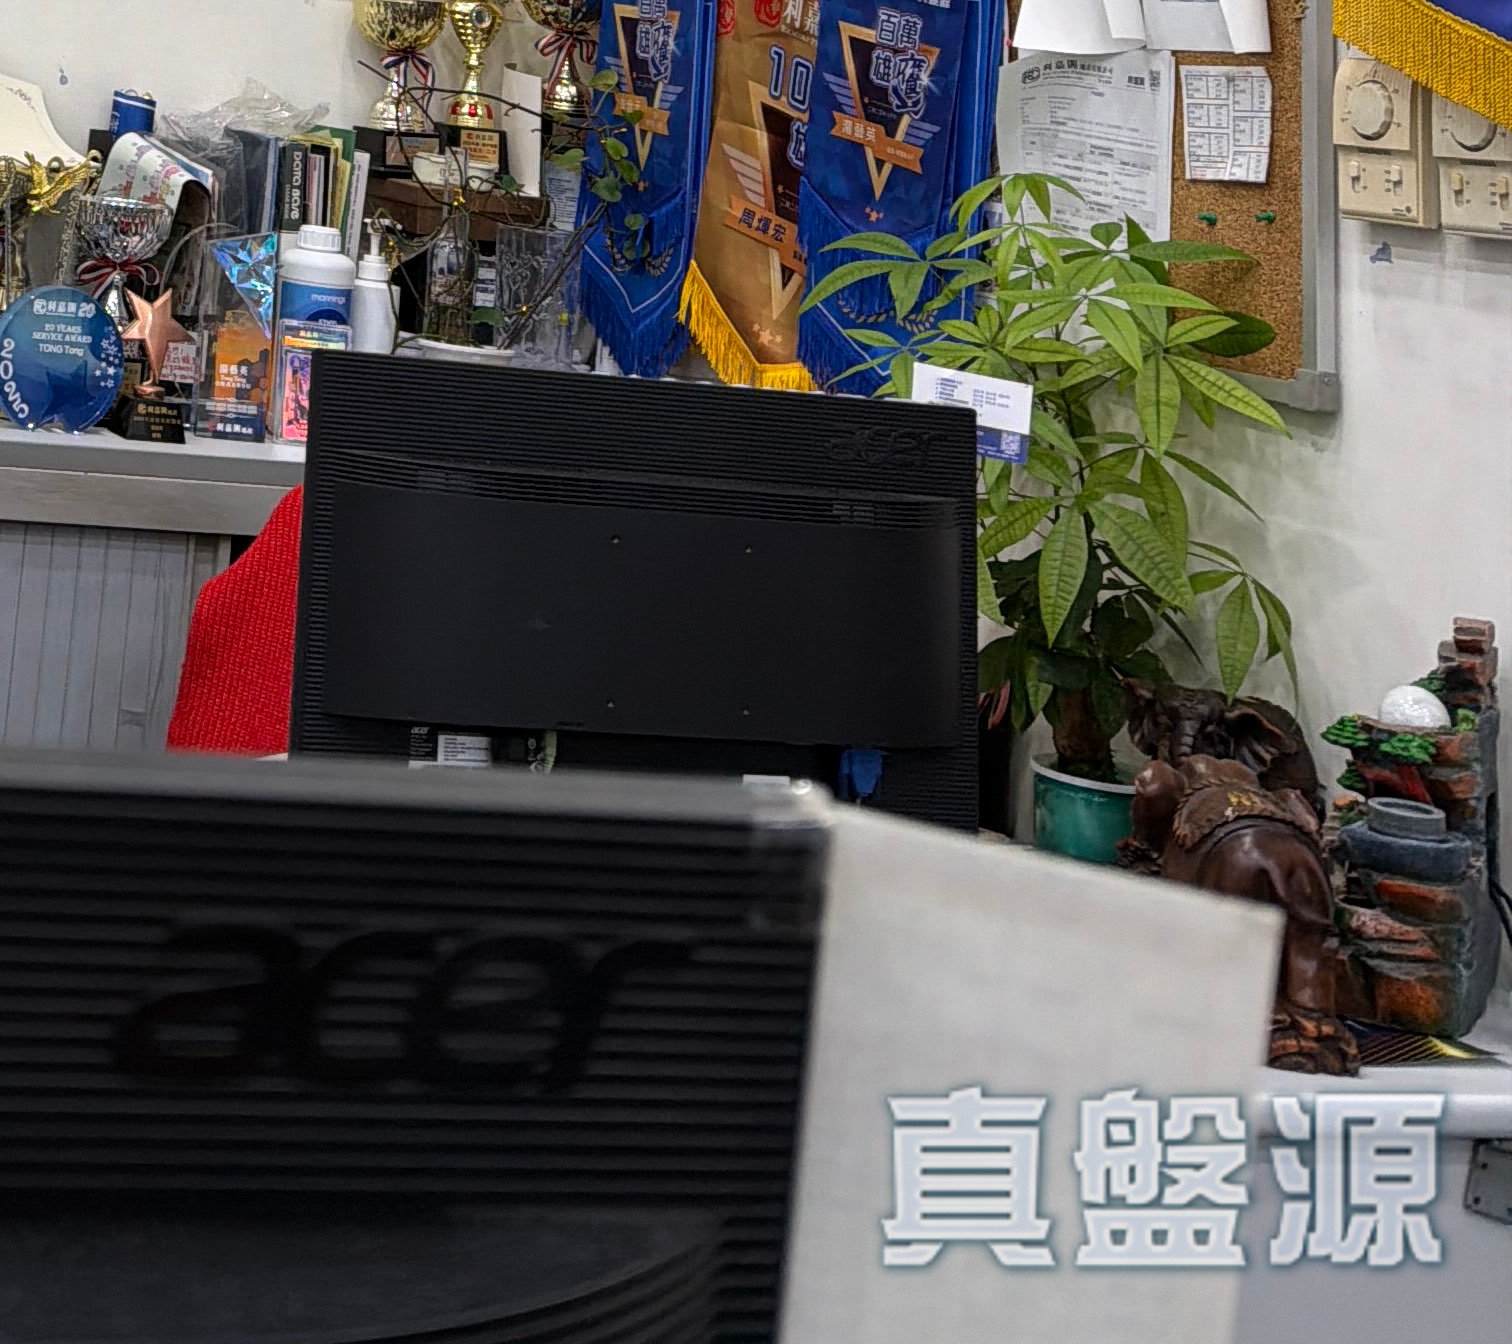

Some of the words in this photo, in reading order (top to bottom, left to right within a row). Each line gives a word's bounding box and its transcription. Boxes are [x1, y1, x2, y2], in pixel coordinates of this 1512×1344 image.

[877, 7, 923, 49] 百萬
[78, 303, 96, 318] 20
[57, 324, 82, 333] YEARS
[32, 332, 63, 341] SERVICE
[65, 335, 92, 343] AWARD
[39, 343, 63, 352] TONG
[64, 345, 84, 356] Tong
[0, 338, 28, 418] 2025
[111, 922, 711, 1091] acer
